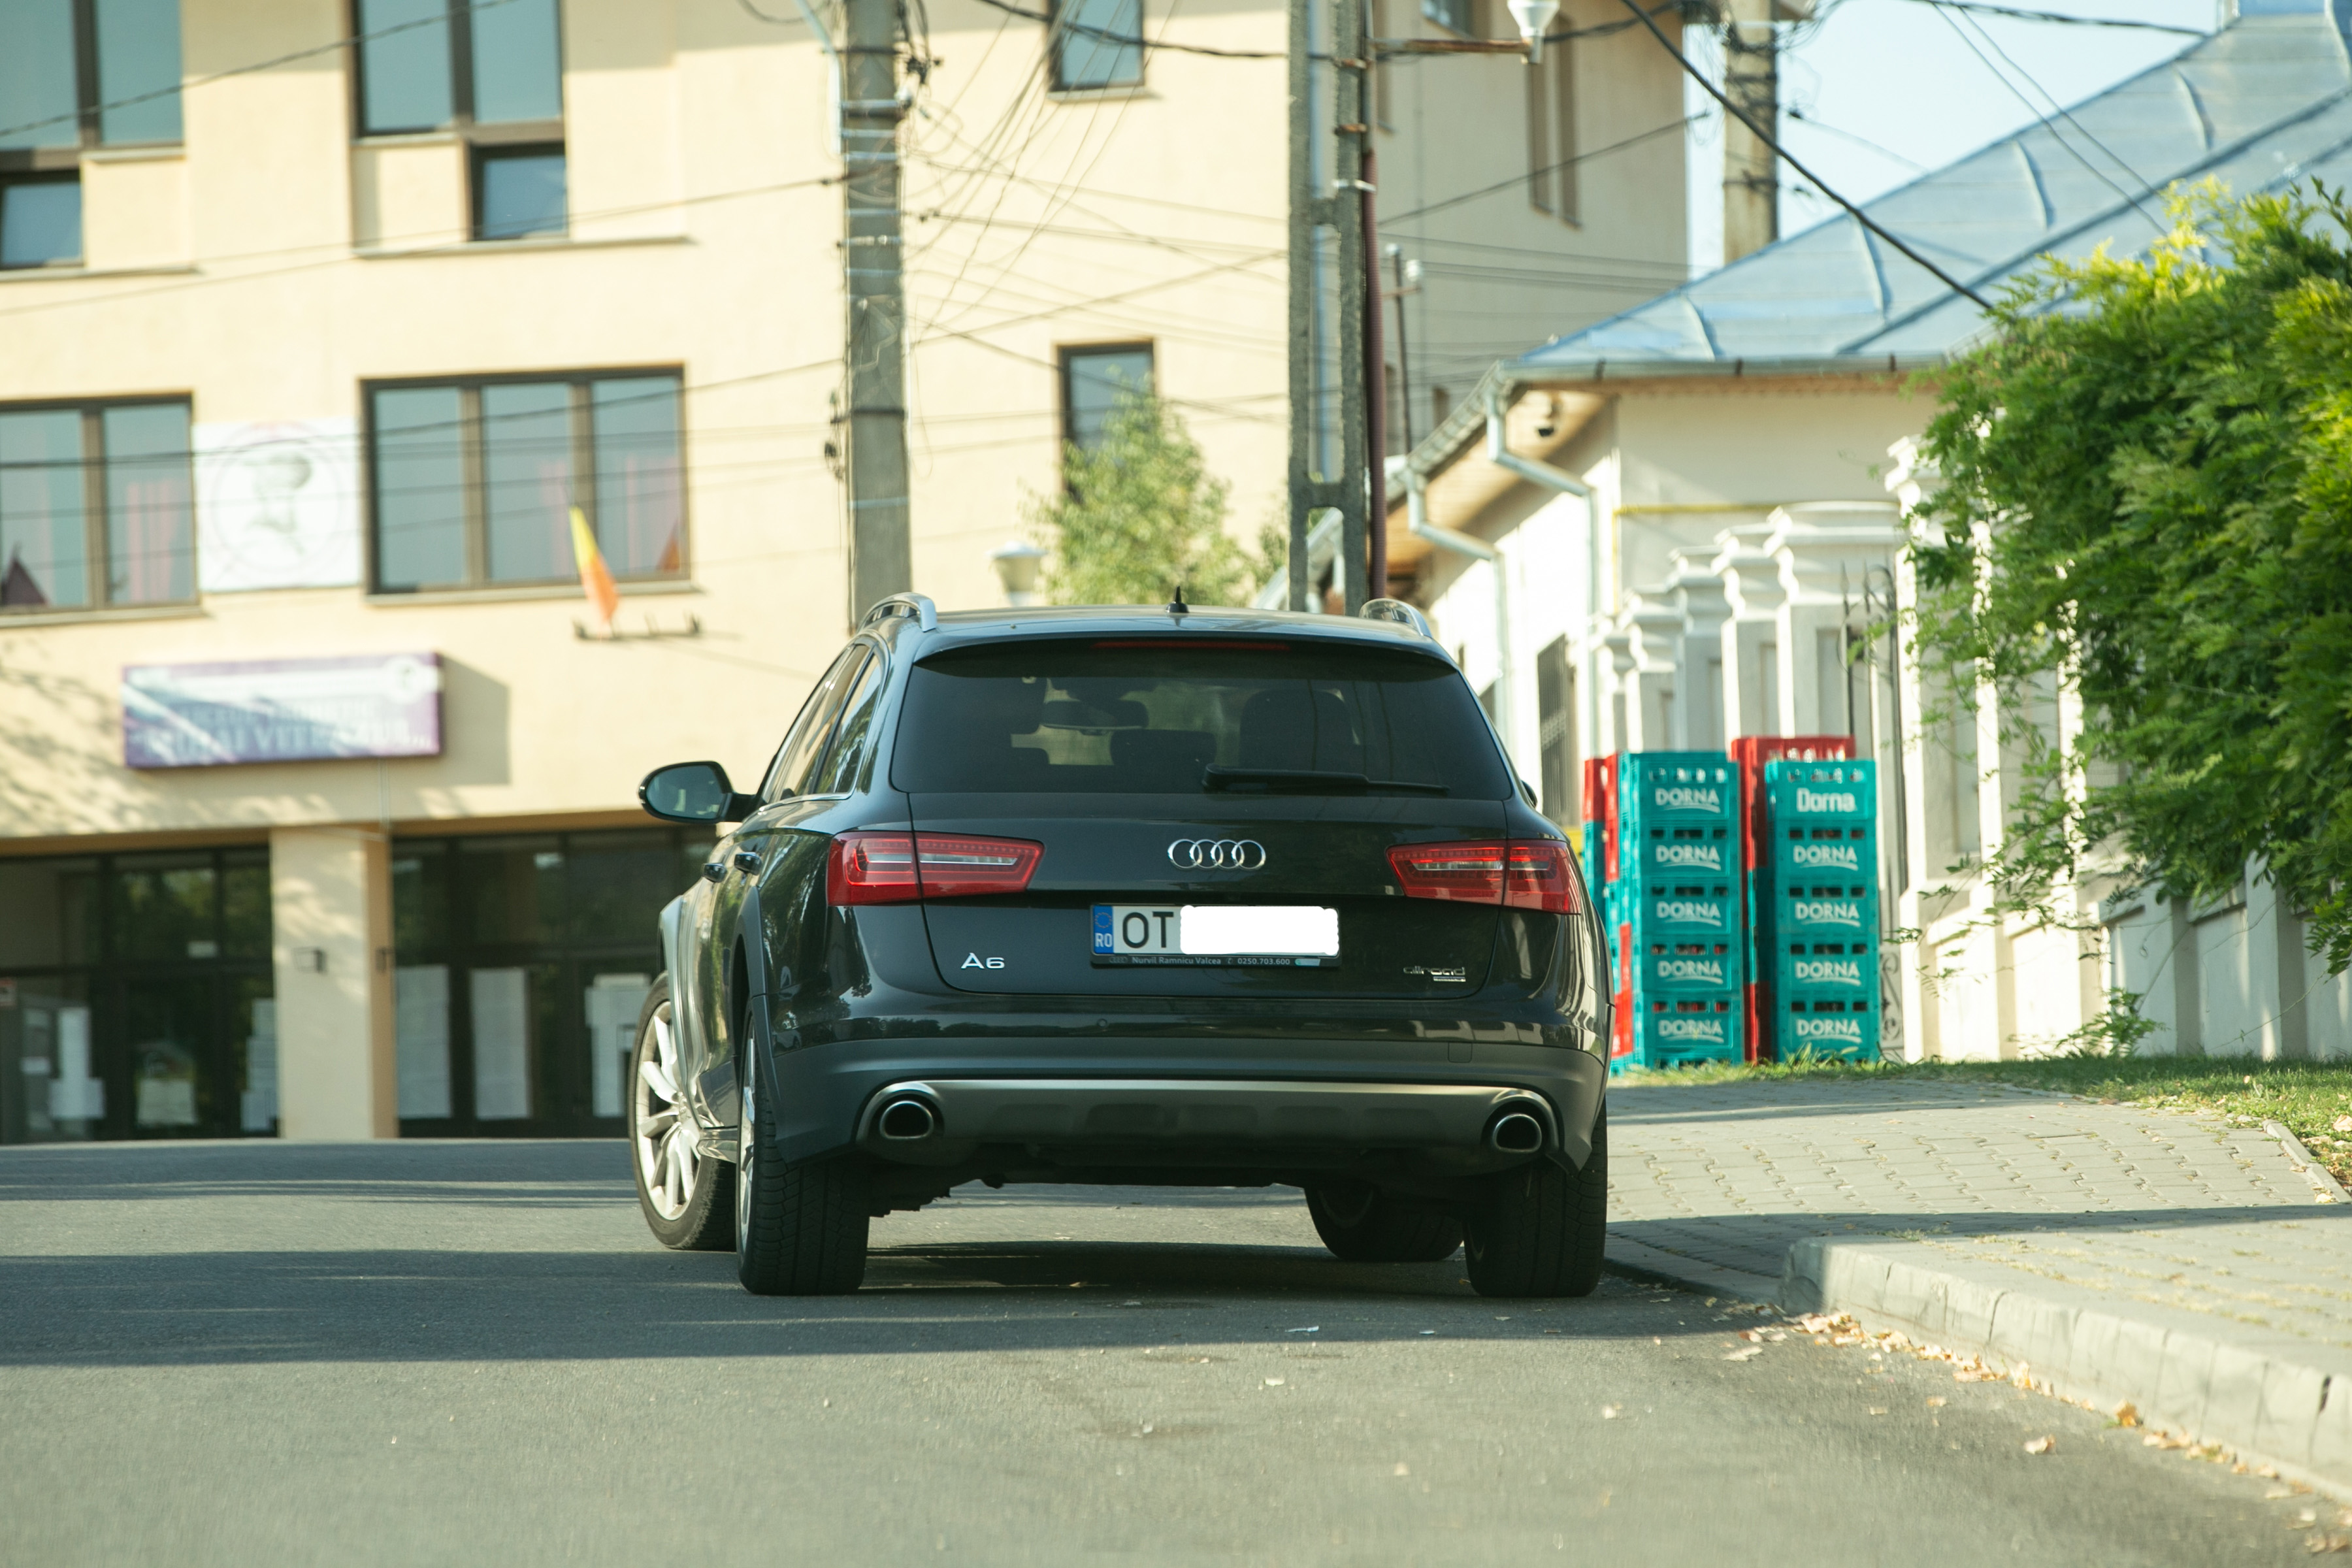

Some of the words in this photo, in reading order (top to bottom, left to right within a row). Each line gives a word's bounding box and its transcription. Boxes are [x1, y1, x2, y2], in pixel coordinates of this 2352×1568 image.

[1655, 787, 1720, 806] DORNA
[1797, 787, 1857, 812] Dorna
[1656, 844, 1721, 862] DORNA
[1793, 844, 1857, 863] DORNA
[1656, 901, 1722, 919] DORNA
[1795, 901, 1859, 920] DORNA
[1122, 911, 1175, 949] OT
[1094, 932, 1113, 948] RO
[960, 952, 1005, 969] A6
[1237, 957, 1290, 966] 0250.703.600
[1658, 960, 1723, 977] DORNA
[1795, 961, 1861, 979] DORNA
[1658, 1019, 1723, 1037] DORNA
[1797, 1018, 1861, 1037] DORNA
